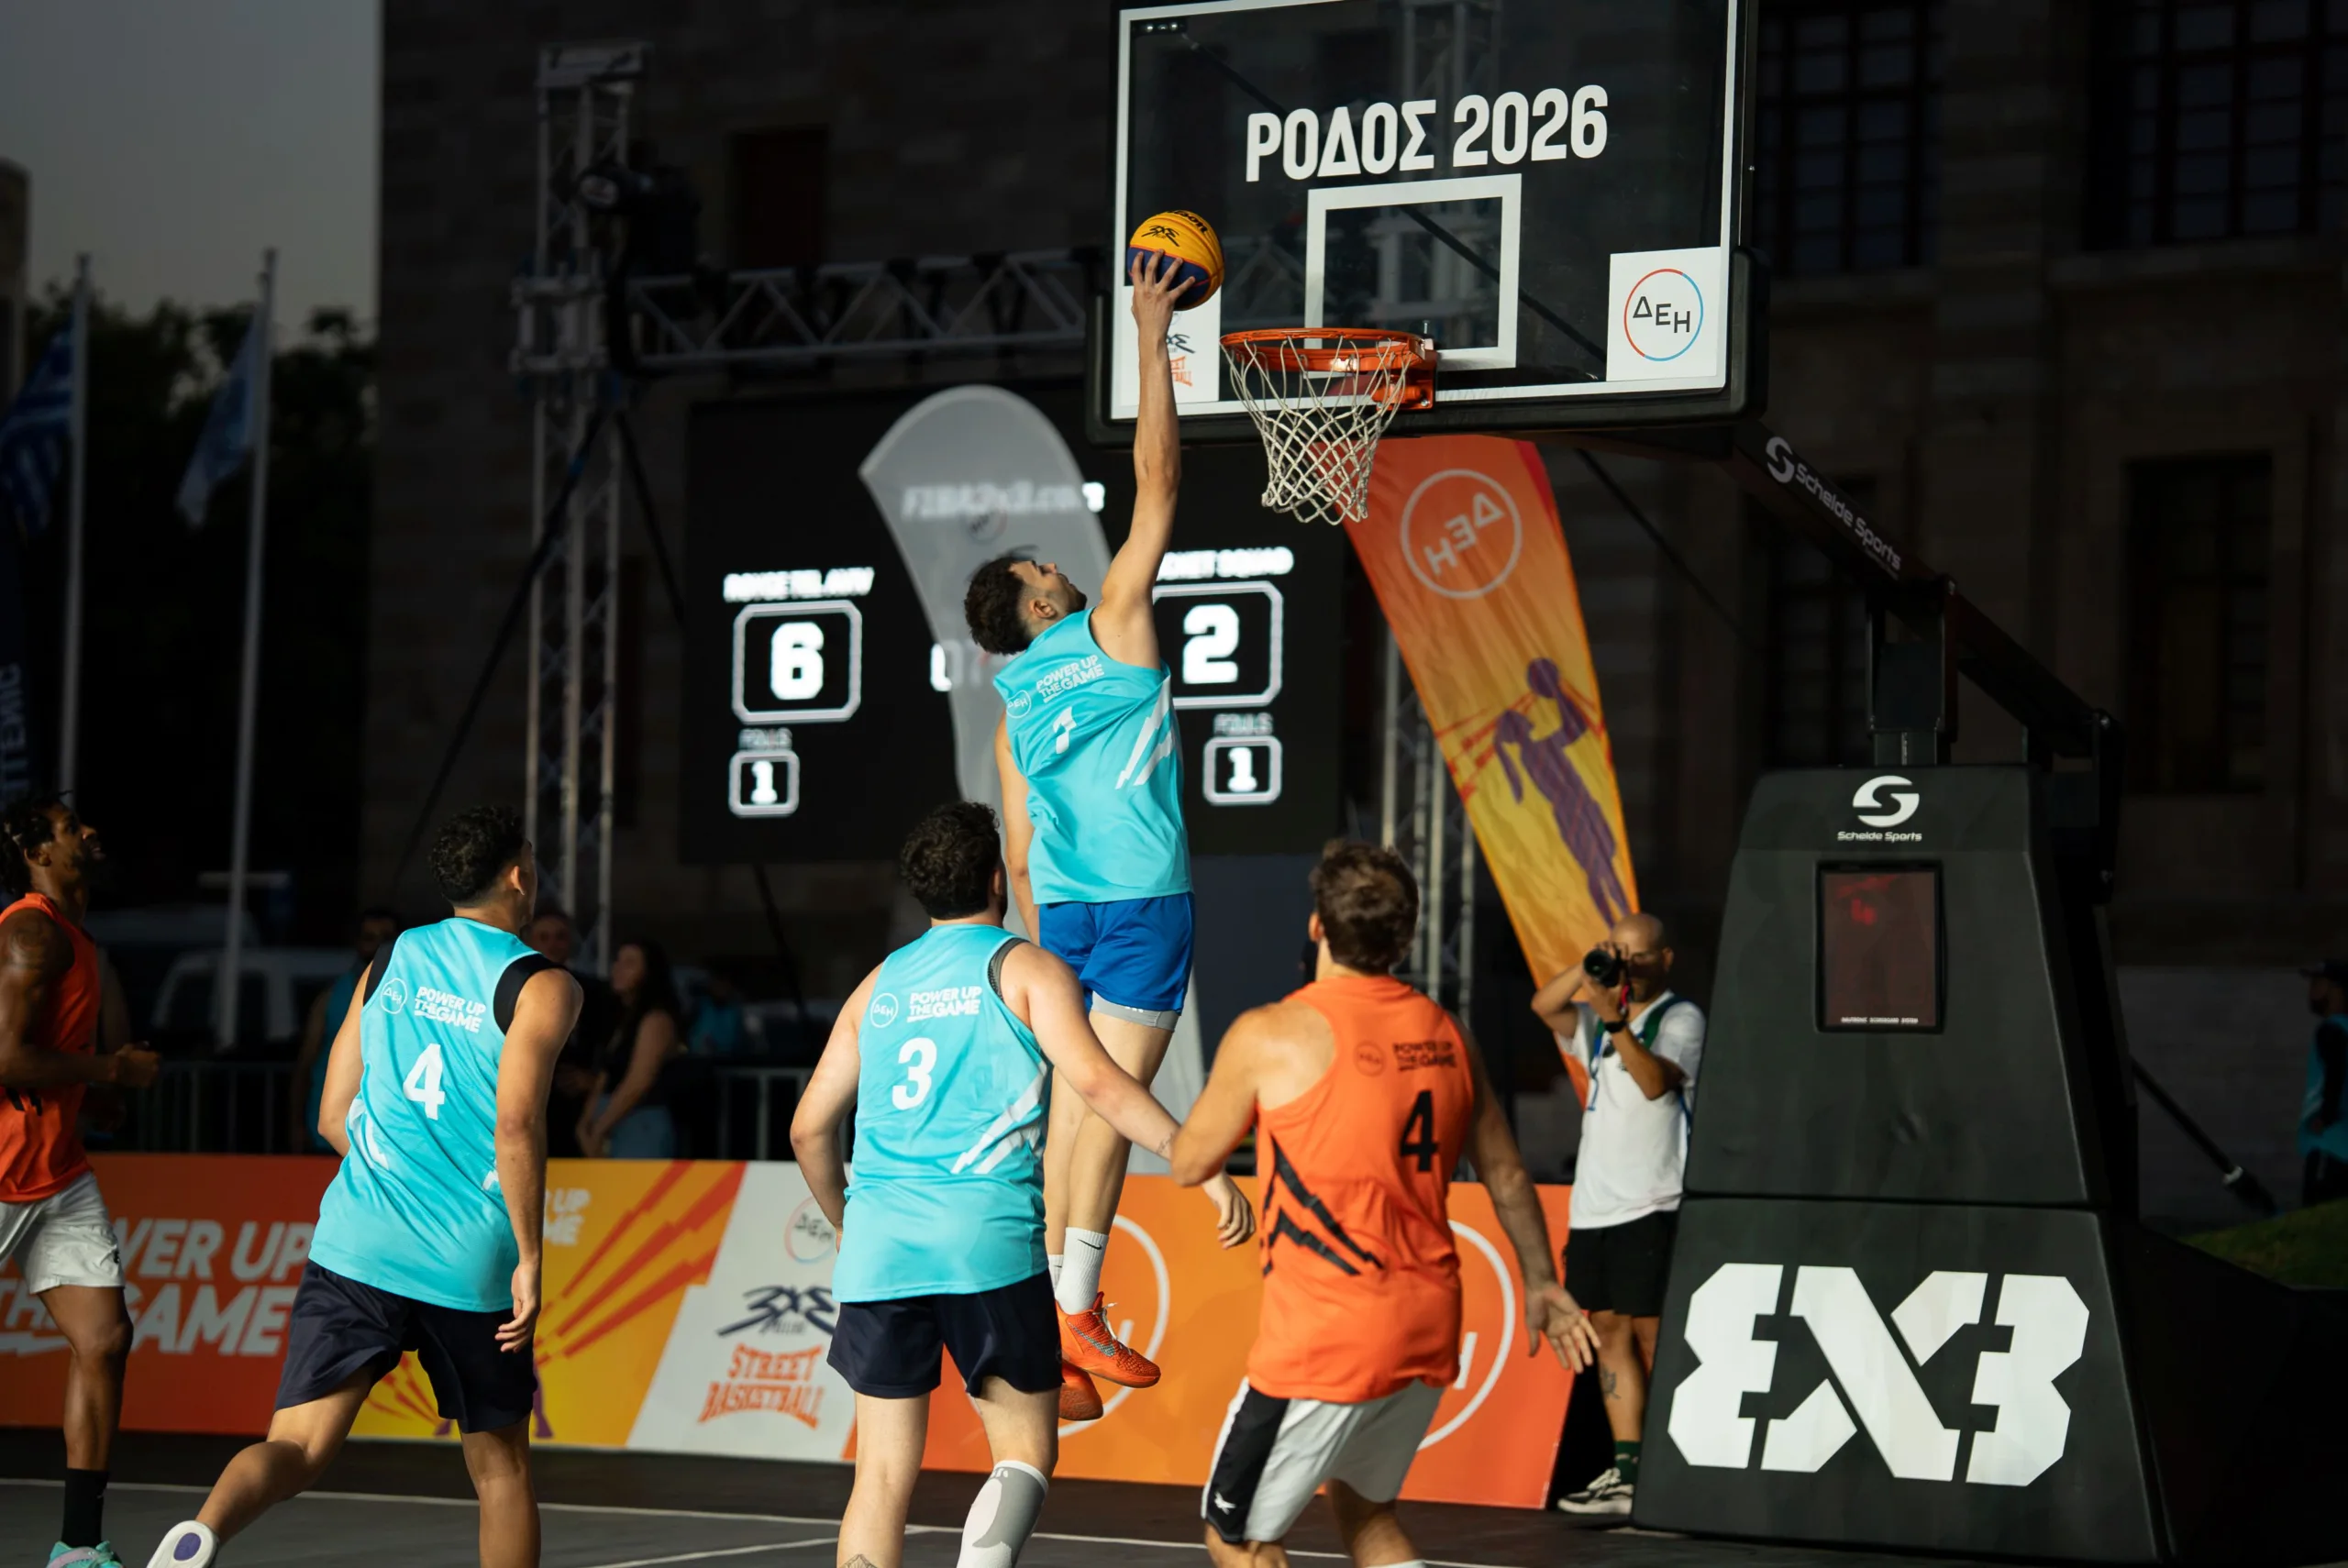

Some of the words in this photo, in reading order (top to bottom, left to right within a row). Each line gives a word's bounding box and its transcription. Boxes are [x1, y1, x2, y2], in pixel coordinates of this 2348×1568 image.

[1246, 99, 1436, 182] ΡΟΔΟΣ
[1453, 84, 1609, 168] 2026
[1633, 295, 1691, 334] ΔΕΗ
[1855, 516, 1901, 571] Sports
[770, 621, 824, 700] 6
[1182, 603, 1239, 684] 2
[1036, 661, 1080, 690] POWER
[1080, 655, 1099, 669] UP
[1038, 682, 1062, 698] THE
[1060, 663, 1105, 690] GAME
[751, 760, 778, 804] 1
[1227, 746, 1257, 793] 1
[1885, 831, 1922, 843] Sports
[415, 999, 437, 1015] THE
[436, 1005, 482, 1034] GAME
[416, 987, 466, 1010] POWER
[466, 1001, 486, 1017] UP
[909, 988, 959, 1005] POWER
[961, 986, 983, 1000] UP
[909, 1004, 933, 1016] THE
[932, 999, 981, 1018] GAME
[403, 1043, 446, 1121] 4
[892, 1037, 937, 1110] 3
[1400, 1088, 1441, 1173] 4
[230, 1220, 316, 1280] UP
[727, 1342, 825, 1382] STREET
